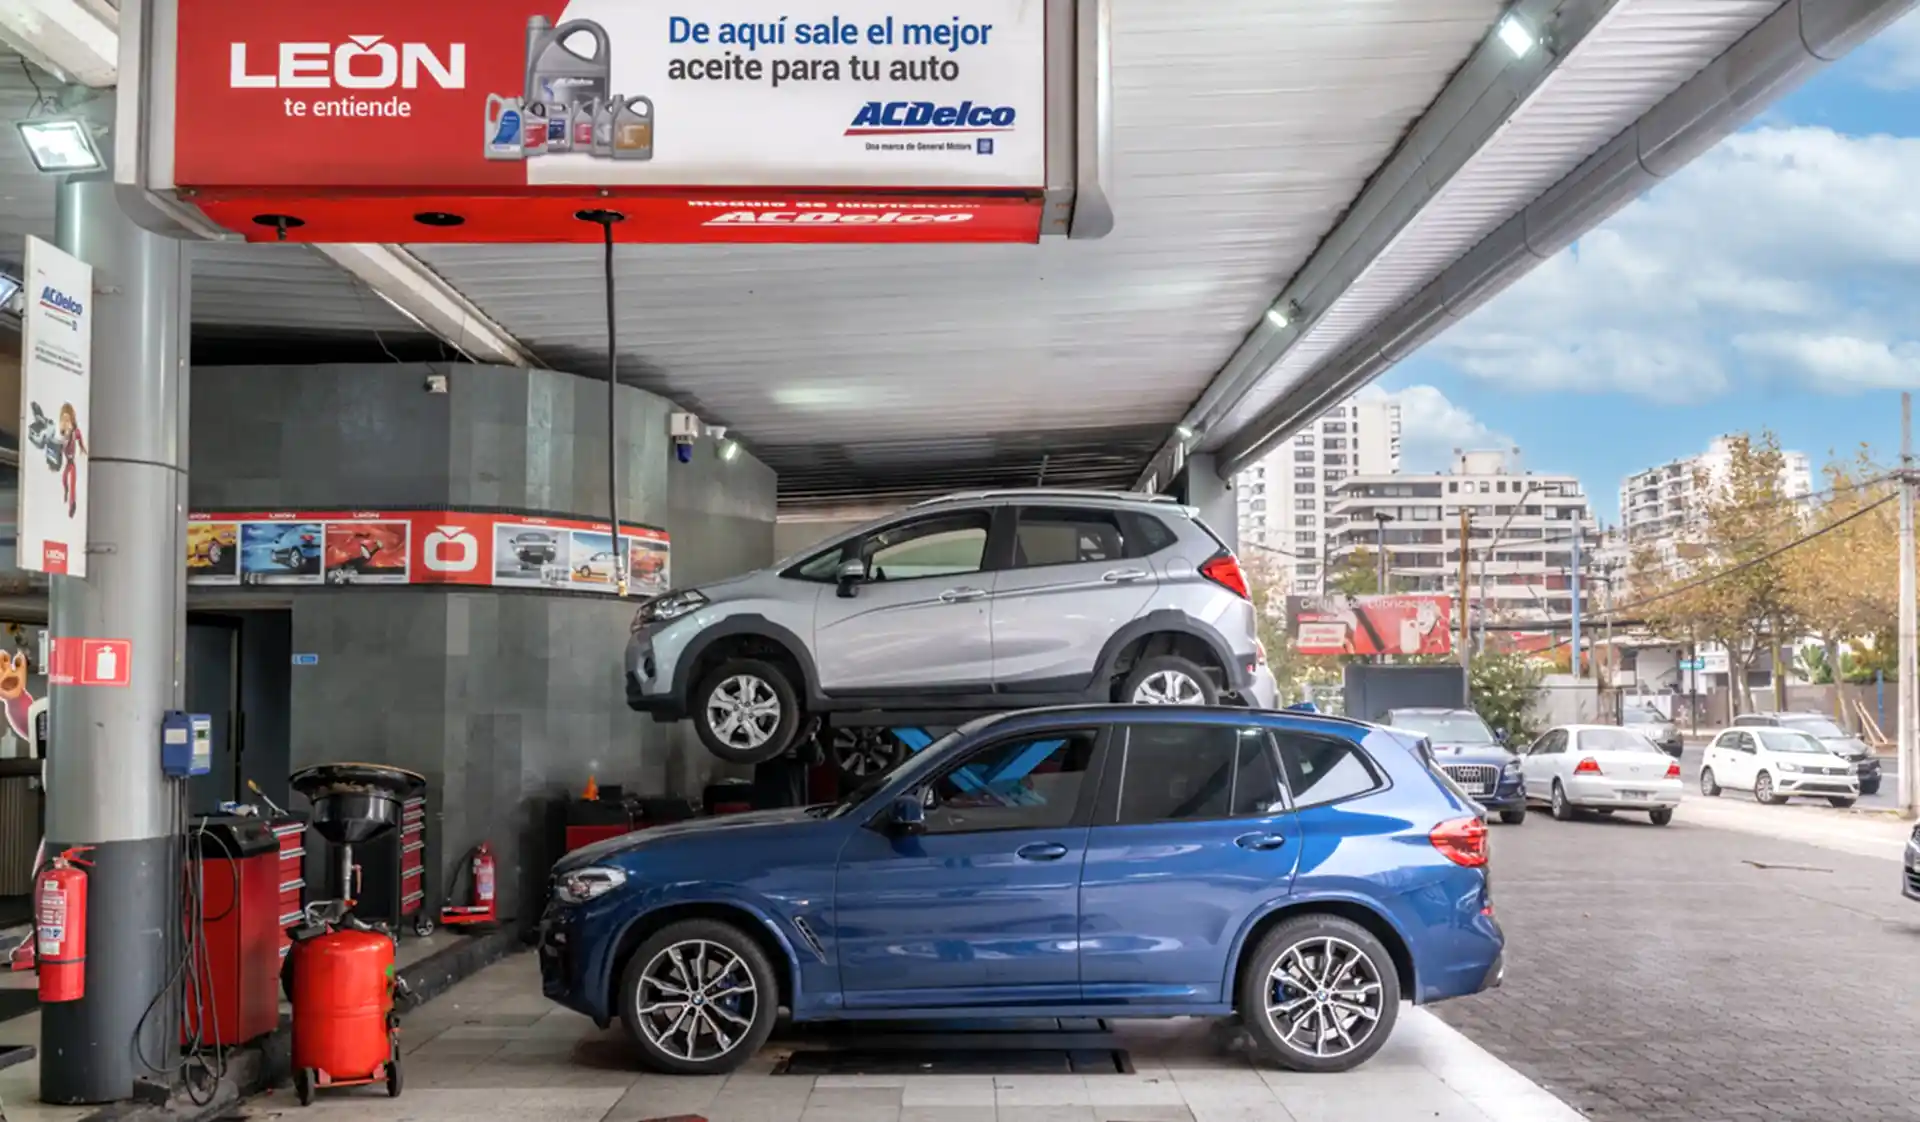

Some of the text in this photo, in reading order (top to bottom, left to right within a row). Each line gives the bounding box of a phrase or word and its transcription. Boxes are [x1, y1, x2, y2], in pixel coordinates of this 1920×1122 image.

[669, 15, 993, 53] De aquí sale el mejor
[668, 51, 960, 87] aceite para tu auto
[284, 95, 412, 118] te entiende
[851, 100, 1016, 127] ACDelco
[906, 142, 915, 151] de
[917, 142, 945, 151] General
[946, 142, 972, 151] Motors
[708, 211, 974, 223] ACDelco
